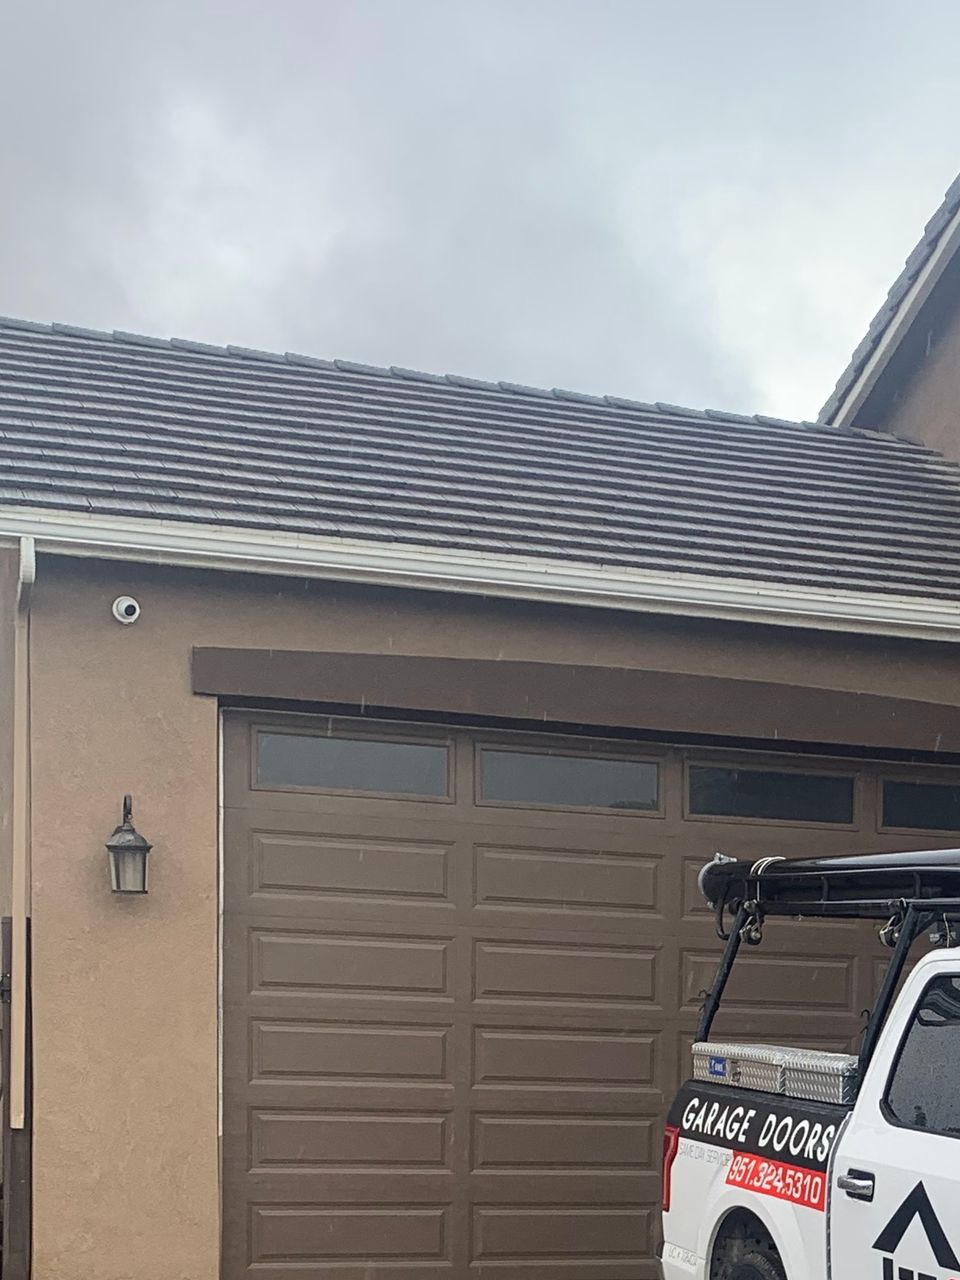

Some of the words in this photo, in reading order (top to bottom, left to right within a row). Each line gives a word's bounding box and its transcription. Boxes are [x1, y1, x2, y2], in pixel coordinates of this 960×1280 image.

[682, 1097, 756, 1143] GARAGE
[758, 1113, 836, 1162] DOORS
[729, 1155, 822, 1204] 951.324.5310
